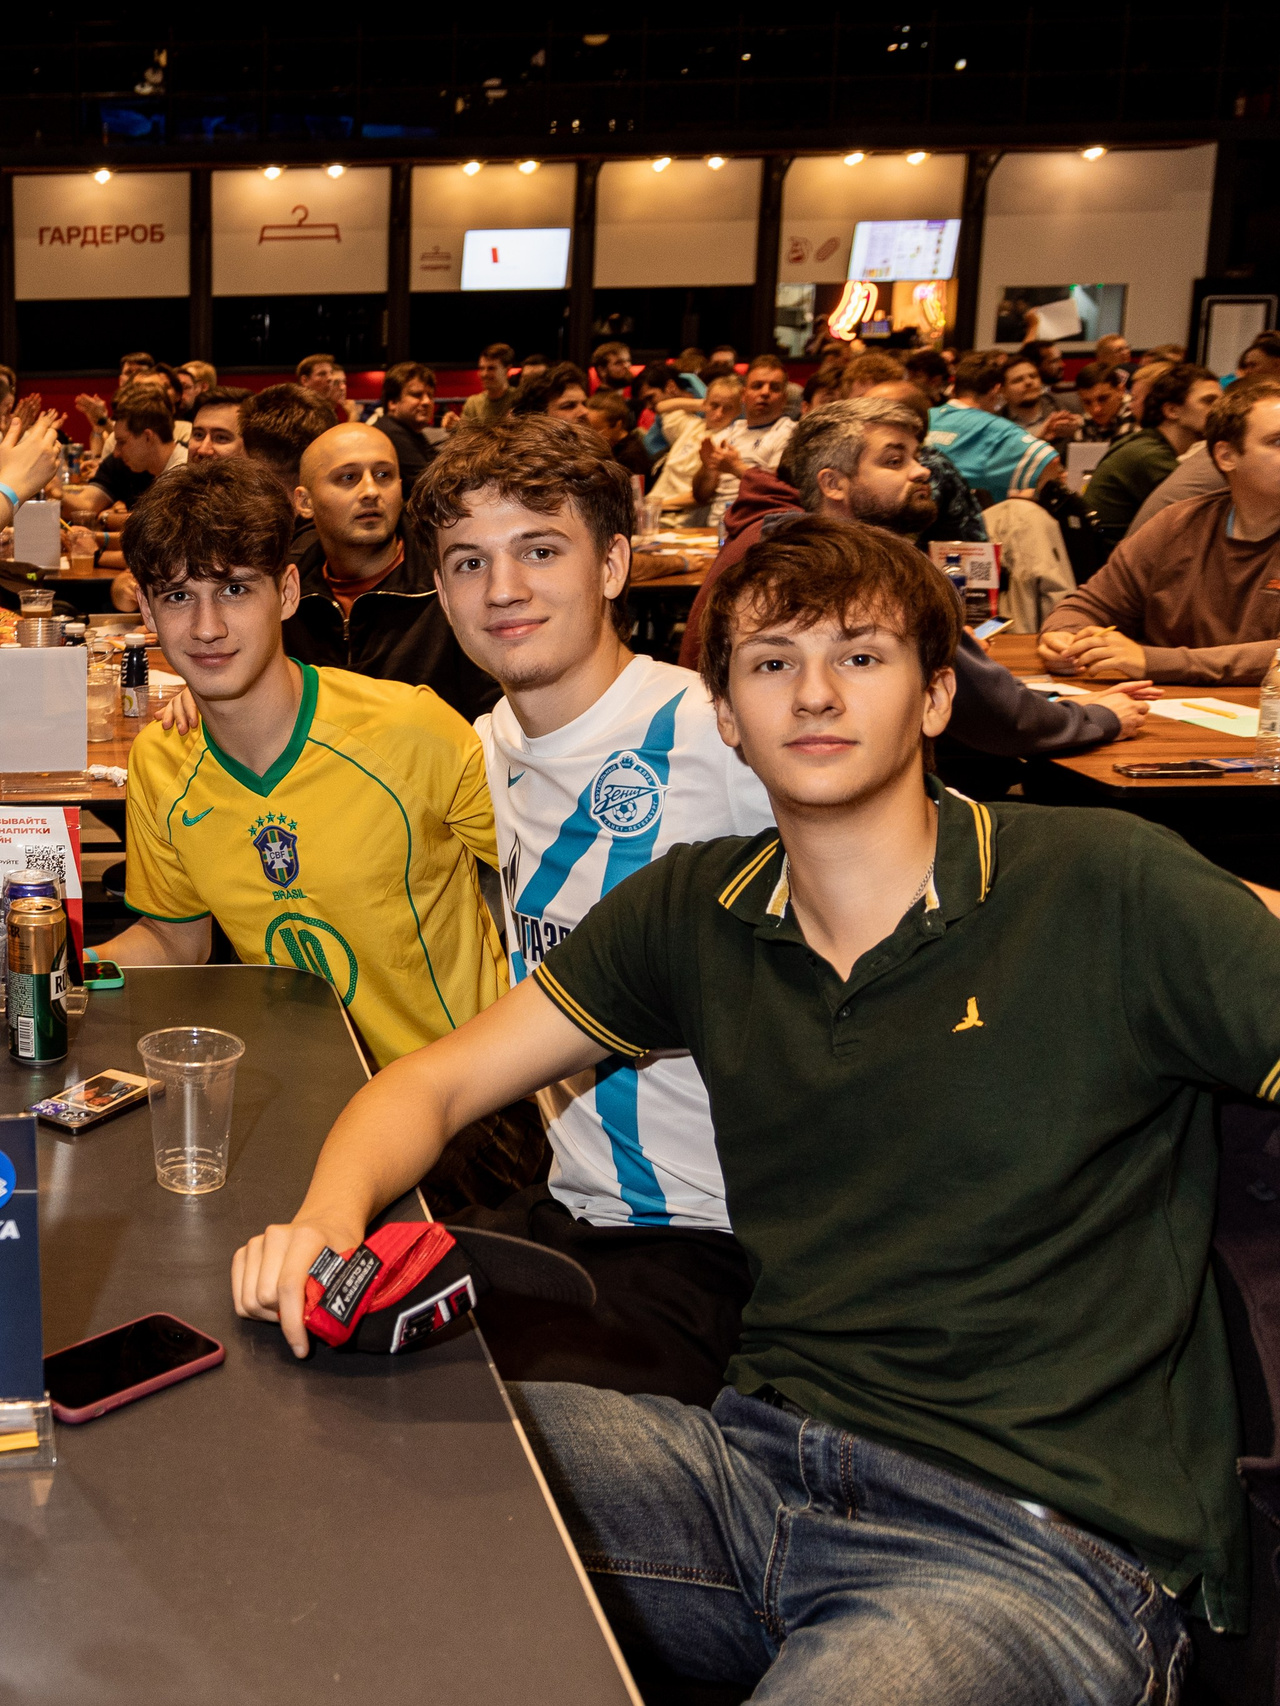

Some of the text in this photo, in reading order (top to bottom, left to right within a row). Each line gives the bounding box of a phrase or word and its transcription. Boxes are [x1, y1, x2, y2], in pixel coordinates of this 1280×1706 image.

[38, 223, 166, 248] ГАРДЕРОБ
[637, 767, 654, 784] КЛУБ
[269, 851, 286, 861] CBF
[272, 888, 308, 901] BRASIL
[279, 927, 336, 986] 10
[343, 1257, 375, 1303] ATRIBUTIKA
